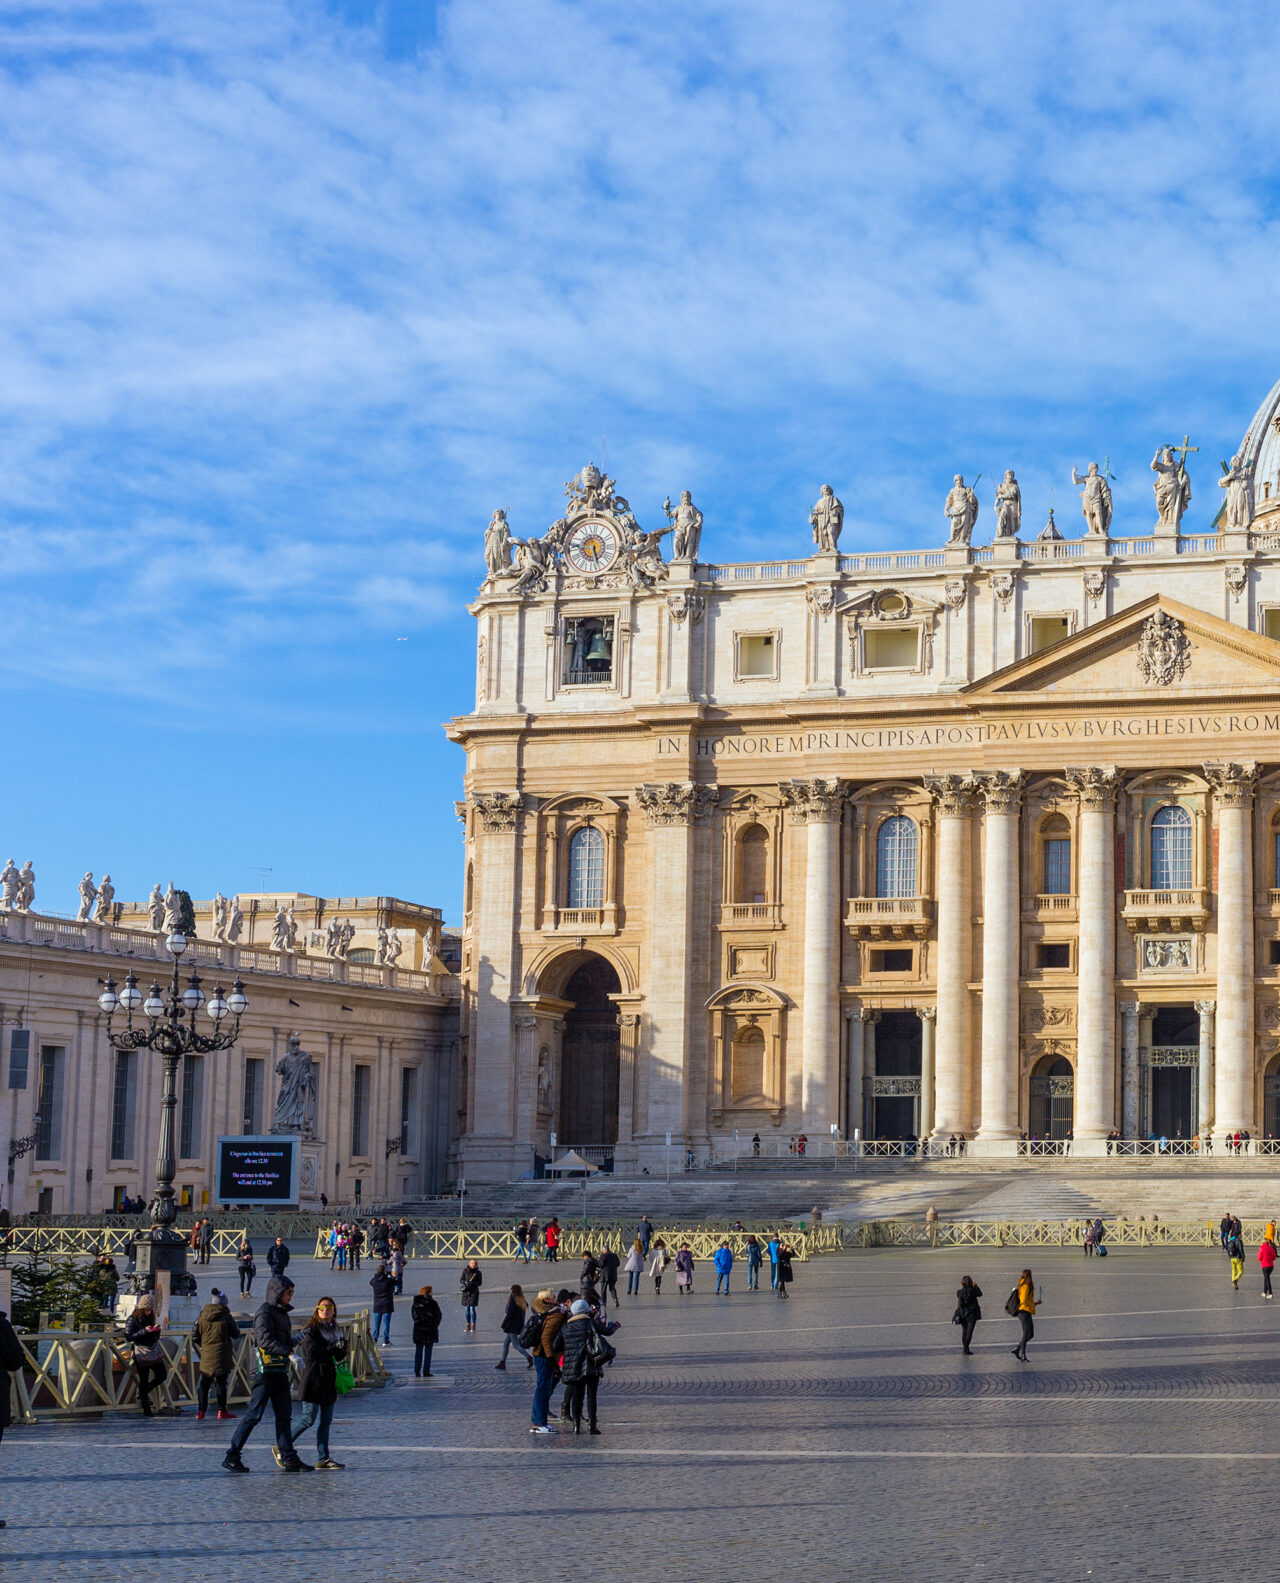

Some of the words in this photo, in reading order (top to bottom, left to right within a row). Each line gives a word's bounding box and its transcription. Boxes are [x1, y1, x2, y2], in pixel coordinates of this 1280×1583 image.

[657, 737, 681, 754] IN
[696, 736, 803, 756] HONOREM
[806, 729, 914, 749] PRINCIPIS
[919, 725, 985, 744] APOST
[985, 721, 1058, 741] PAVLVS
[1065, 720, 1078, 737] V
[1083, 716, 1222, 737] BVRGHESIVS
